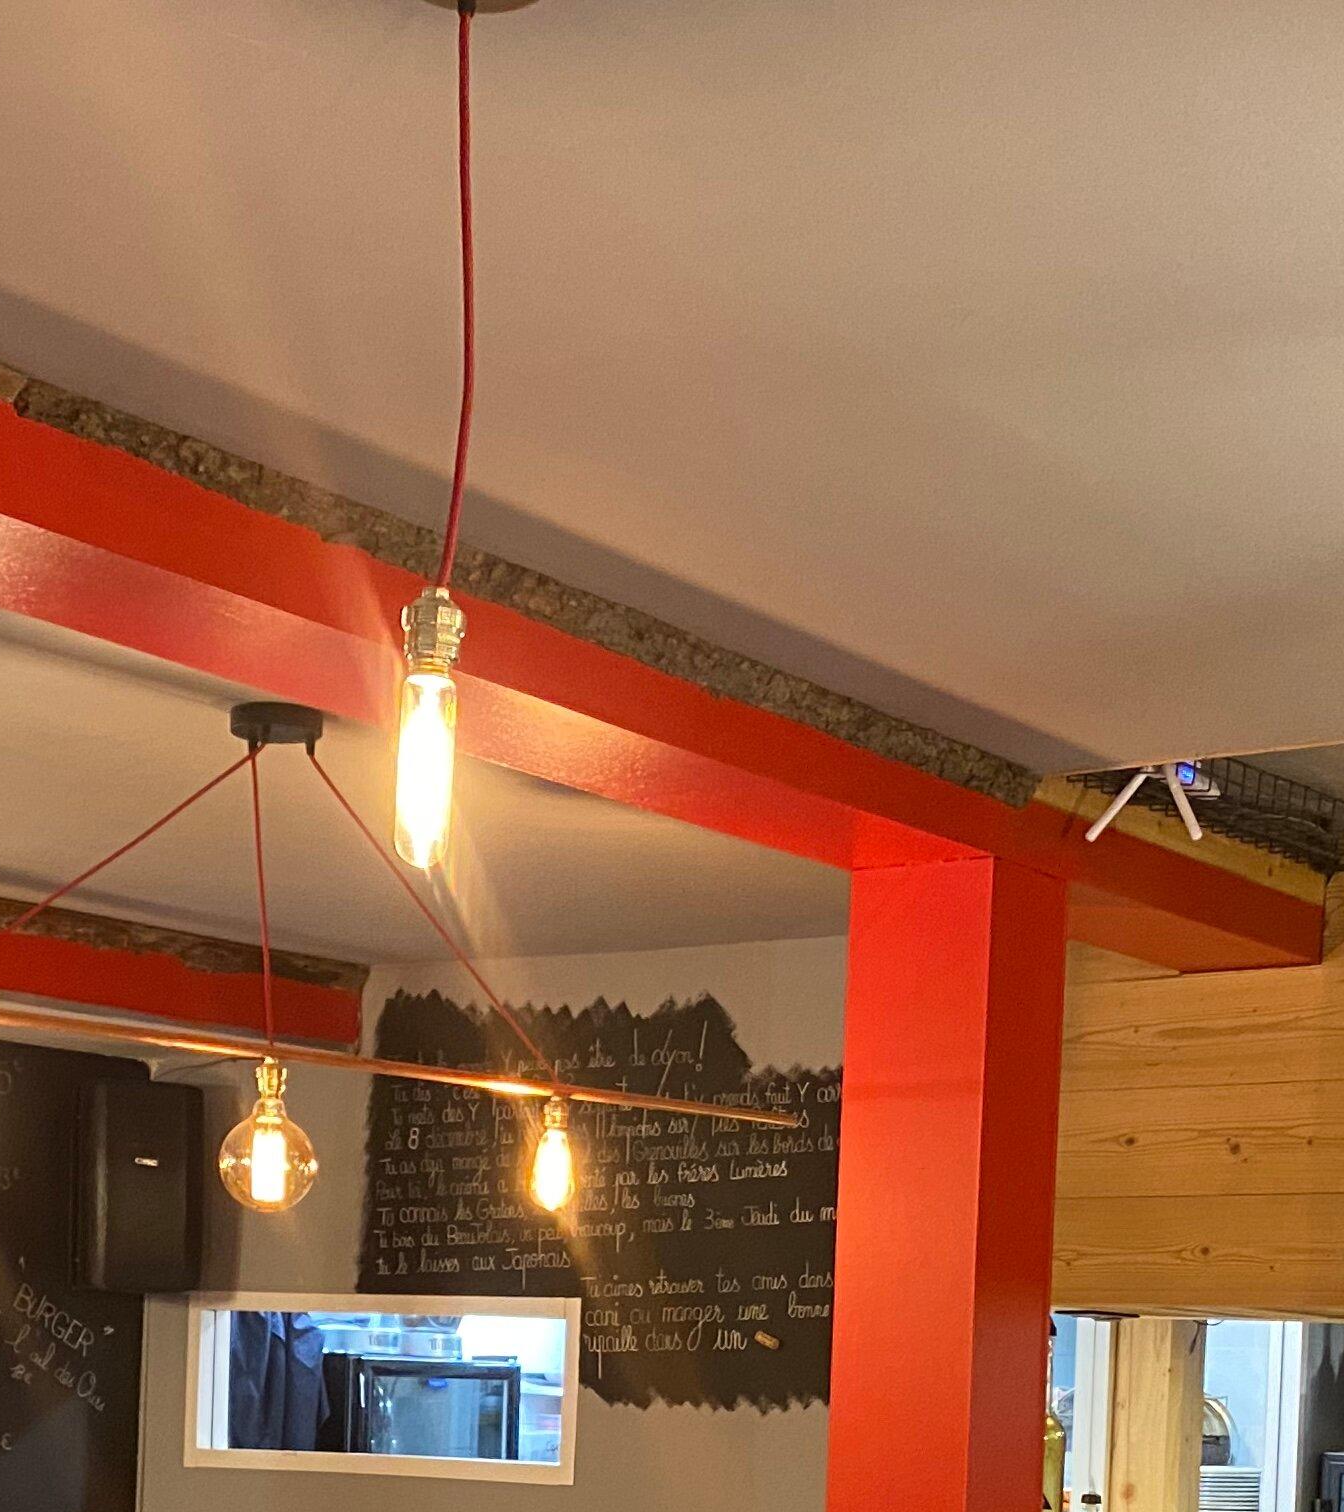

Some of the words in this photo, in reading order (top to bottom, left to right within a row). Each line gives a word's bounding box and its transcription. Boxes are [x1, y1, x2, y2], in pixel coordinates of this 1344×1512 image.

[796, 1081, 811, 1103] Y
[407, 1127, 420, 1151] 8
[646, 1159, 670, 1186] les
[420, 1224, 440, 1247] du
[642, 1216, 675, 1234] mais
[789, 1195, 814, 1225] du
[471, 1254, 496, 1272] aux
[501, 1247, 572, 1292] Japonais
[713, 1266, 743, 1295] tes
[751, 1274, 790, 1292] amis
[12, 1282, 96, 1358] BURGER
[662, 1302, 726, 1352] manger
[737, 1302, 771, 1322] une
[712, 1327, 749, 1352] un
